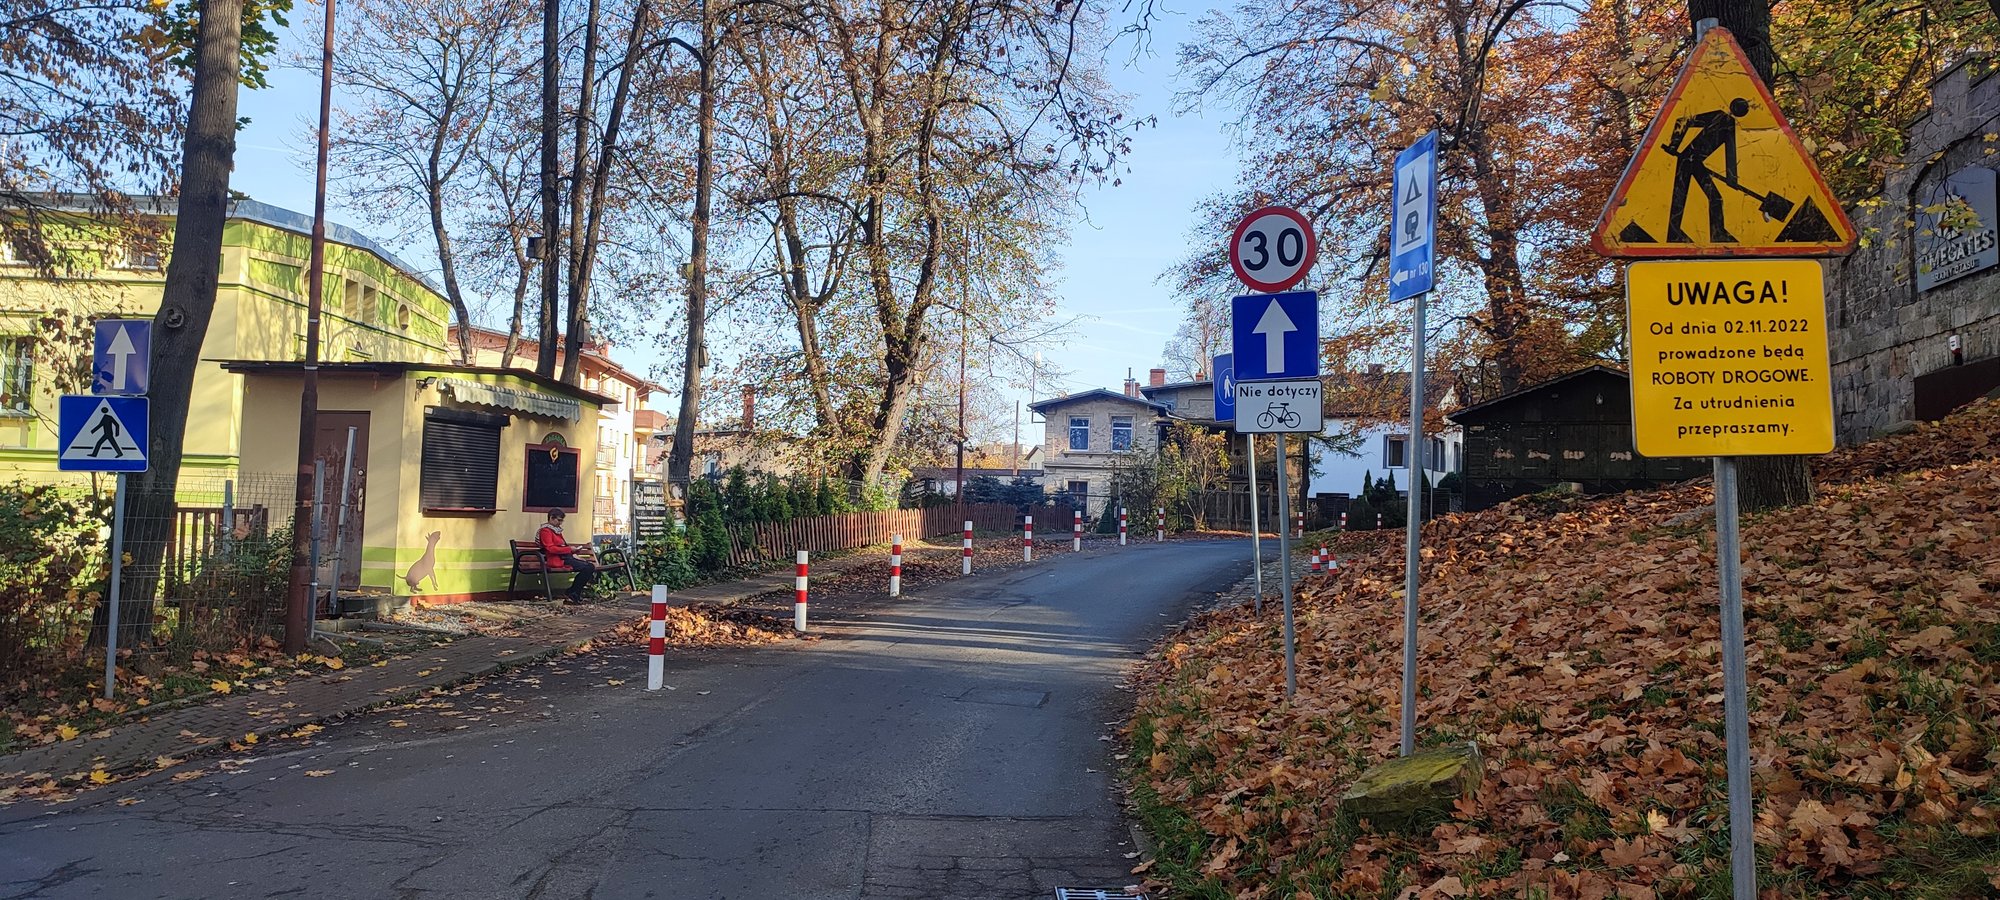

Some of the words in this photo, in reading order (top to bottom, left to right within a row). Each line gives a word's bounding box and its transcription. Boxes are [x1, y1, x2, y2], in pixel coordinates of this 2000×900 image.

[1243, 227, 1304, 271] 30
[1410, 269, 1416, 278] nr
[1419, 261, 1428, 276] 130
[1667, 280, 1788, 306] UWAGA!
[1650, 322, 1673, 336] Od
[1680, 321, 1717, 335] dnia
[1724, 318, 1808, 334] 02.11.2022
[1658, 346, 1756, 364] prowadzone
[1763, 344, 1804, 361] będą
[1652, 371, 1716, 385] ROBOTY
[1722, 368, 1814, 384] DROGOWE.
[1240, 386, 1262, 397] Nie
[1268, 386, 1318, 399] dotyczy
[1673, 396, 1693, 410] Za
[1700, 394, 1795, 410] utrudnienia
[1678, 423, 1794, 439] przepraszamy.
